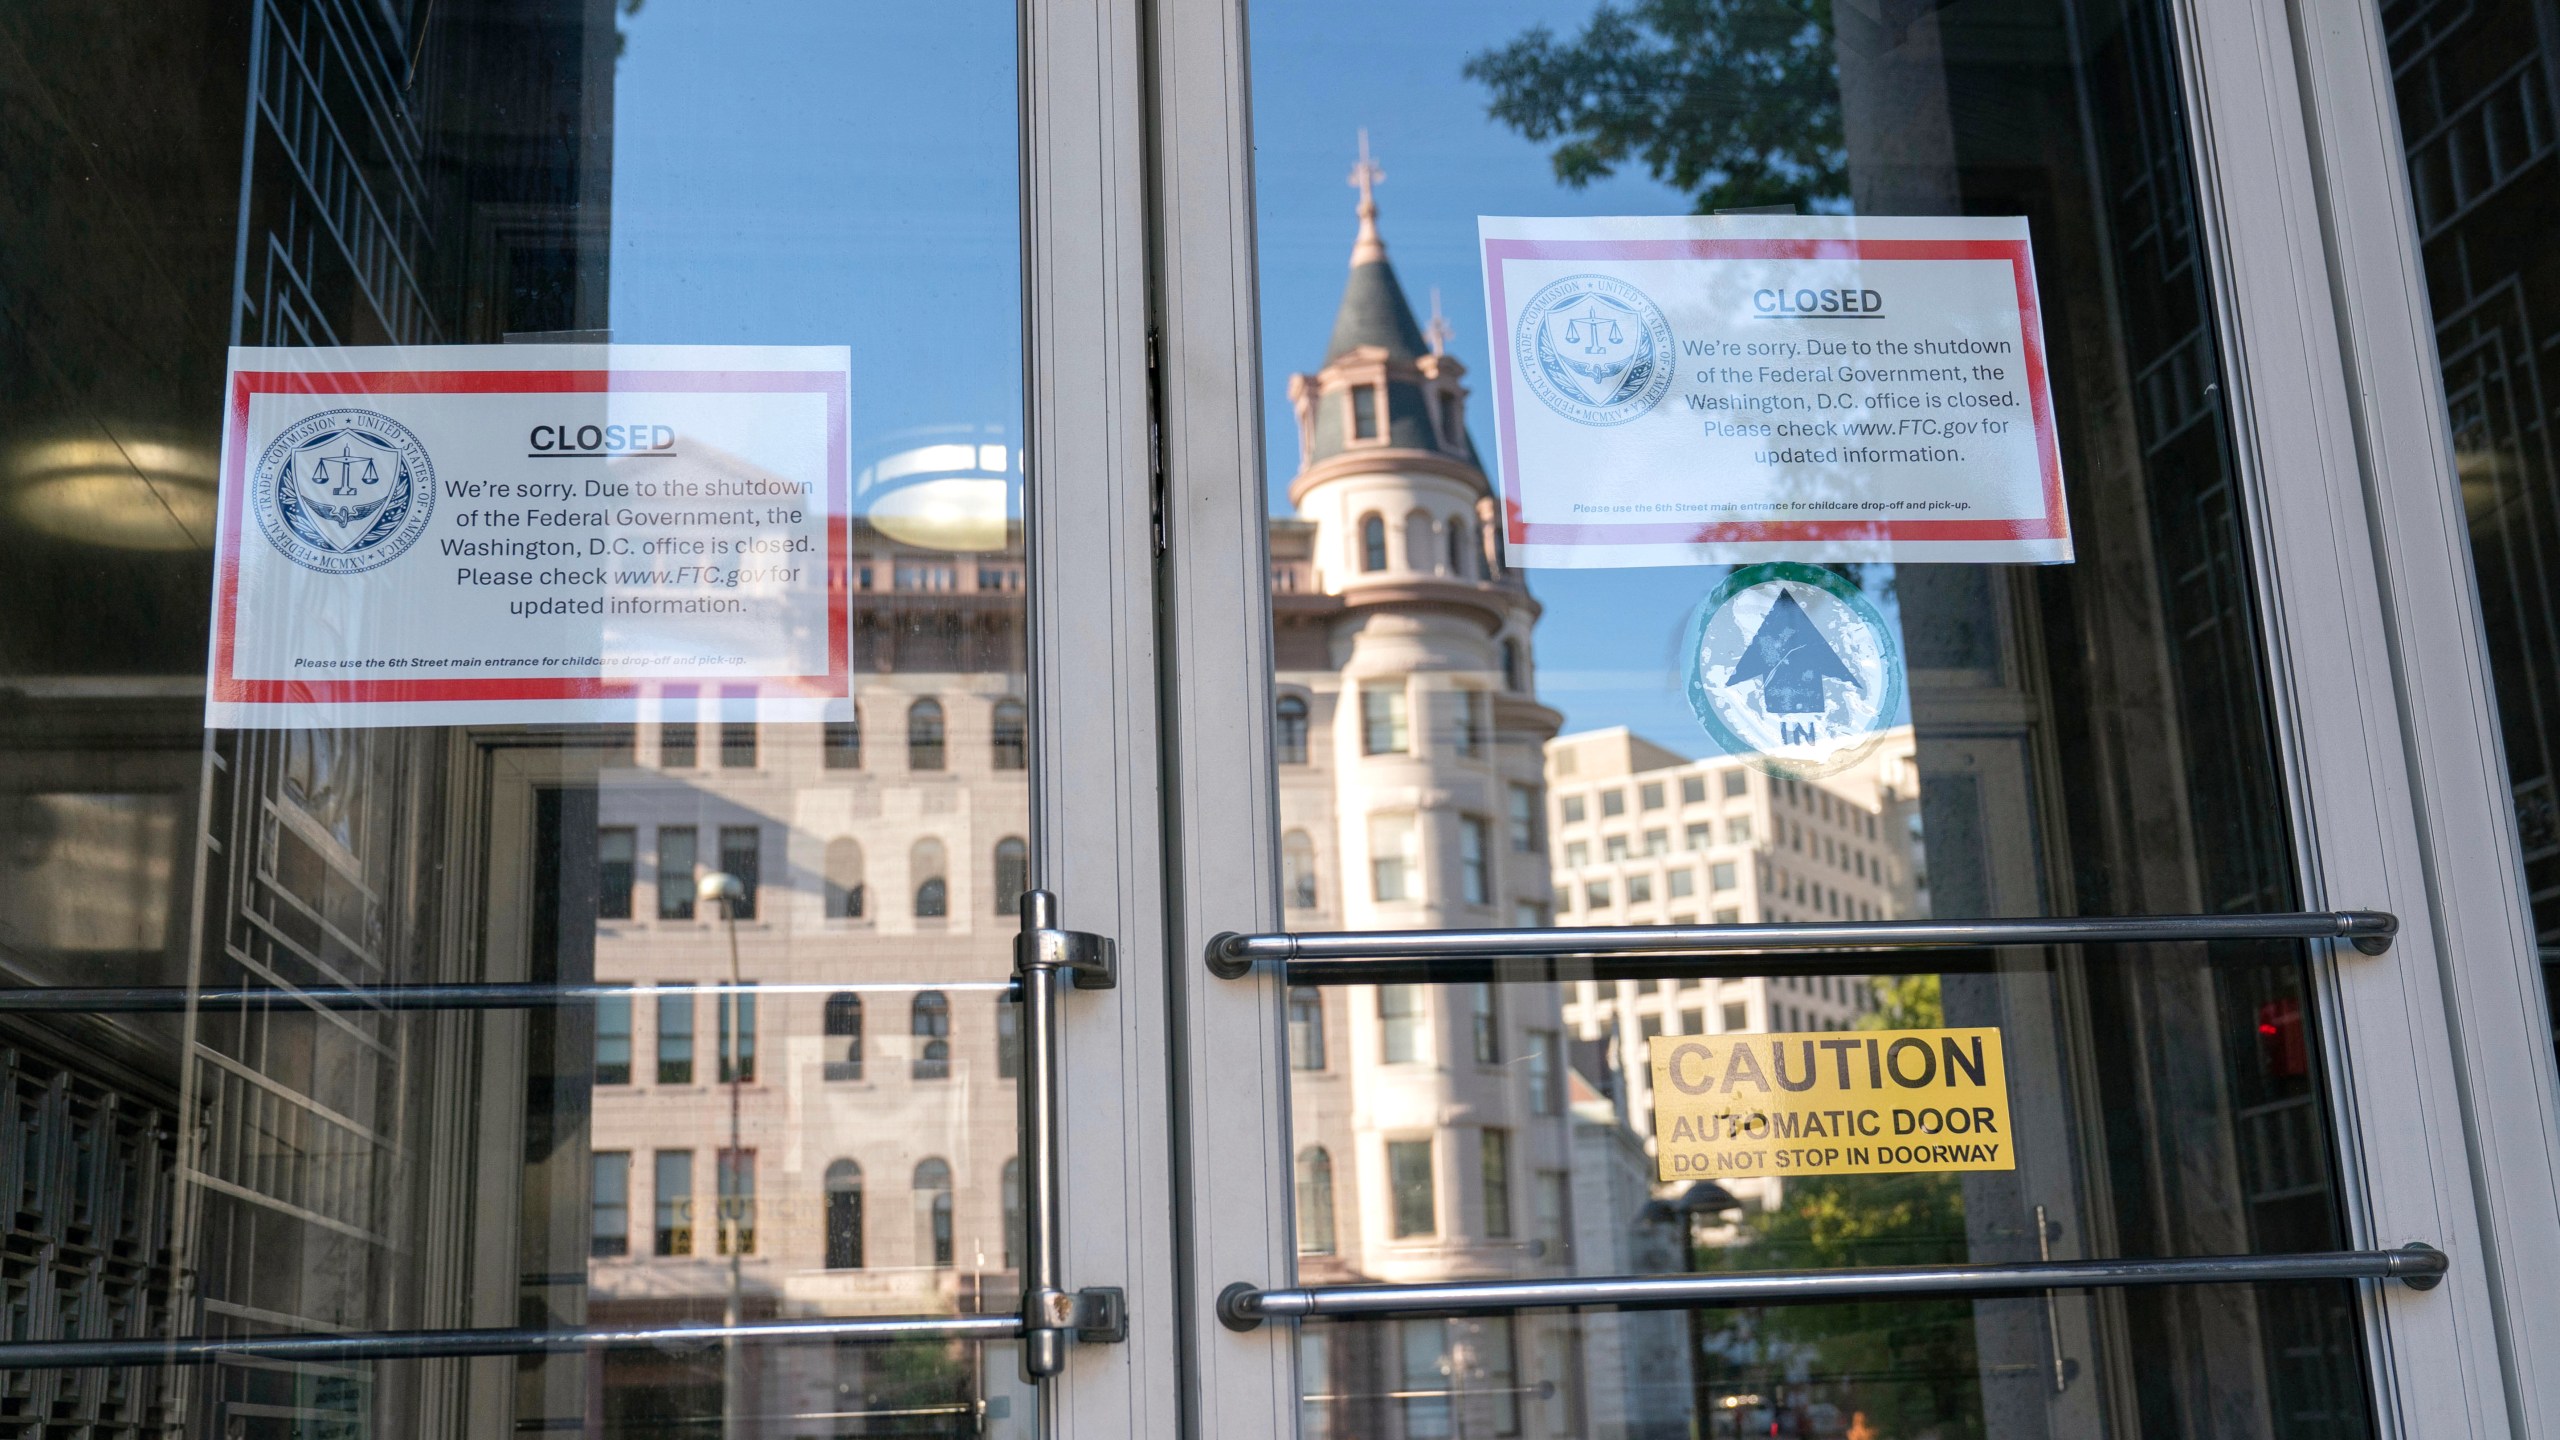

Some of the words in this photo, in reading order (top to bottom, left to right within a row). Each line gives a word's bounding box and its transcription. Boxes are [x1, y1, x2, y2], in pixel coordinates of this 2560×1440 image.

[1598, 281, 1638, 301] UNITED
[1753, 289, 1882, 312] CLOSED
[1527, 281, 1580, 325] COMMISSION
[1641, 304, 1667, 343] STATES
[1522, 333, 1535, 368] TRADE
[1660, 351, 1671, 366] OF
[1683, 340, 1741, 356] We’re
[1747, 343, 1800, 359] sorry.
[1807, 339, 1846, 355] Due
[1852, 340, 1872, 355] to
[1877, 340, 1908, 355] the
[1914, 339, 2011, 354] shutdown
[1696, 367, 1716, 383] of
[1721, 367, 1753, 382] the
[1759, 366, 1833, 382] Federal
[1839, 366, 1967, 384] Government,
[1972, 365, 2004, 381] the
[1533, 376, 1573, 414] FEDERAL
[1631, 372, 1665, 411] AMERICA
[1685, 394, 1811, 413] Washington,
[1818, 393, 1858, 409] D.C.
[1865, 392, 1920, 408] office
[1926, 392, 1942, 408] is
[1948, 391, 2020, 407] closed.
[1582, 409, 1623, 422] MCMXV
[357, 416, 401, 439] UNITED
[530, 425, 675, 450] CLOSED
[1704, 421, 1771, 437] Please
[1777, 420, 1837, 436] check
[1843, 419, 1978, 439] www.FTC.gov
[1982, 418, 2009, 433] for
[270, 417, 336, 465] COMMISSION
[402, 442, 428, 483] STATES
[1755, 448, 1837, 466] updated
[1844, 446, 1965, 462] information.
[259, 473, 272, 510] TRADE
[418, 492, 430, 508] OF
[444, 480, 510, 498] We’re
[517, 484, 577, 502] sorry.
[586, 480, 629, 498] Due
[636, 481, 657, 497] to
[663, 480, 698, 497] the
[705, 479, 814, 497] shutdown
[457, 510, 479, 527] of
[484, 510, 520, 527] the
[528, 509, 610, 527] Federal
[617, 509, 761, 528] Government,
[767, 507, 803, 524] the
[1573, 503, 1610, 513] Please
[1635, 503, 1653, 512] the
[1655, 503, 1673, 512] 6th
[1675, 503, 1708, 512] Street
[1711, 503, 1737, 511] main
[1740, 502, 1788, 511] entrance
[1791, 501, 1806, 510] for
[1809, 501, 1858, 510] childcare
[1861, 500, 1904, 512] drop-off
[1907, 500, 1926, 509] and
[1929, 500, 1971, 511] pick-up.
[268, 518, 313, 560] FEDERAL
[377, 515, 422, 557] AMERICA
[441, 538, 582, 561] Washington,
[590, 538, 635, 555] D.C.
[643, 537, 704, 555] office
[712, 537, 729, 554] is
[735, 536, 815, 553] closed.
[319, 555, 366, 569] MCMXV
[458, 568, 533, 586] Please
[540, 567, 607, 585] check
[614, 567, 767, 588] www.FTC.gov
[771, 566, 801, 582] for
[510, 597, 604, 618] updated
[612, 596, 747, 614] information.
[295, 658, 336, 668] Please
[340, 659, 362, 667] use
[366, 658, 385, 667] the
[389, 658, 408, 667] 6th
[411, 657, 449, 667] Street
[451, 657, 481, 667] main
[485, 657, 539, 666] entrance
[542, 656, 559, 666] for
[562, 656, 619, 666] childcare
[622, 655, 670, 667] drop-off
[673, 656, 696, 665] and
[698, 655, 747, 667] pick-up.
[1780, 721, 1816, 747] IN
[1669, 1035, 1987, 1096] CAUTION
[1671, 1110, 1880, 1143] AUTOMATIC
[1893, 1107, 1998, 1136] DOOR
[1674, 1153, 1709, 1173] DO
[1717, 1150, 1768, 1170] NOT
[1776, 1148, 1839, 1168] STOP
[1846, 1146, 1870, 1165] IN
[1878, 1144, 1999, 1165] DOORWAY
